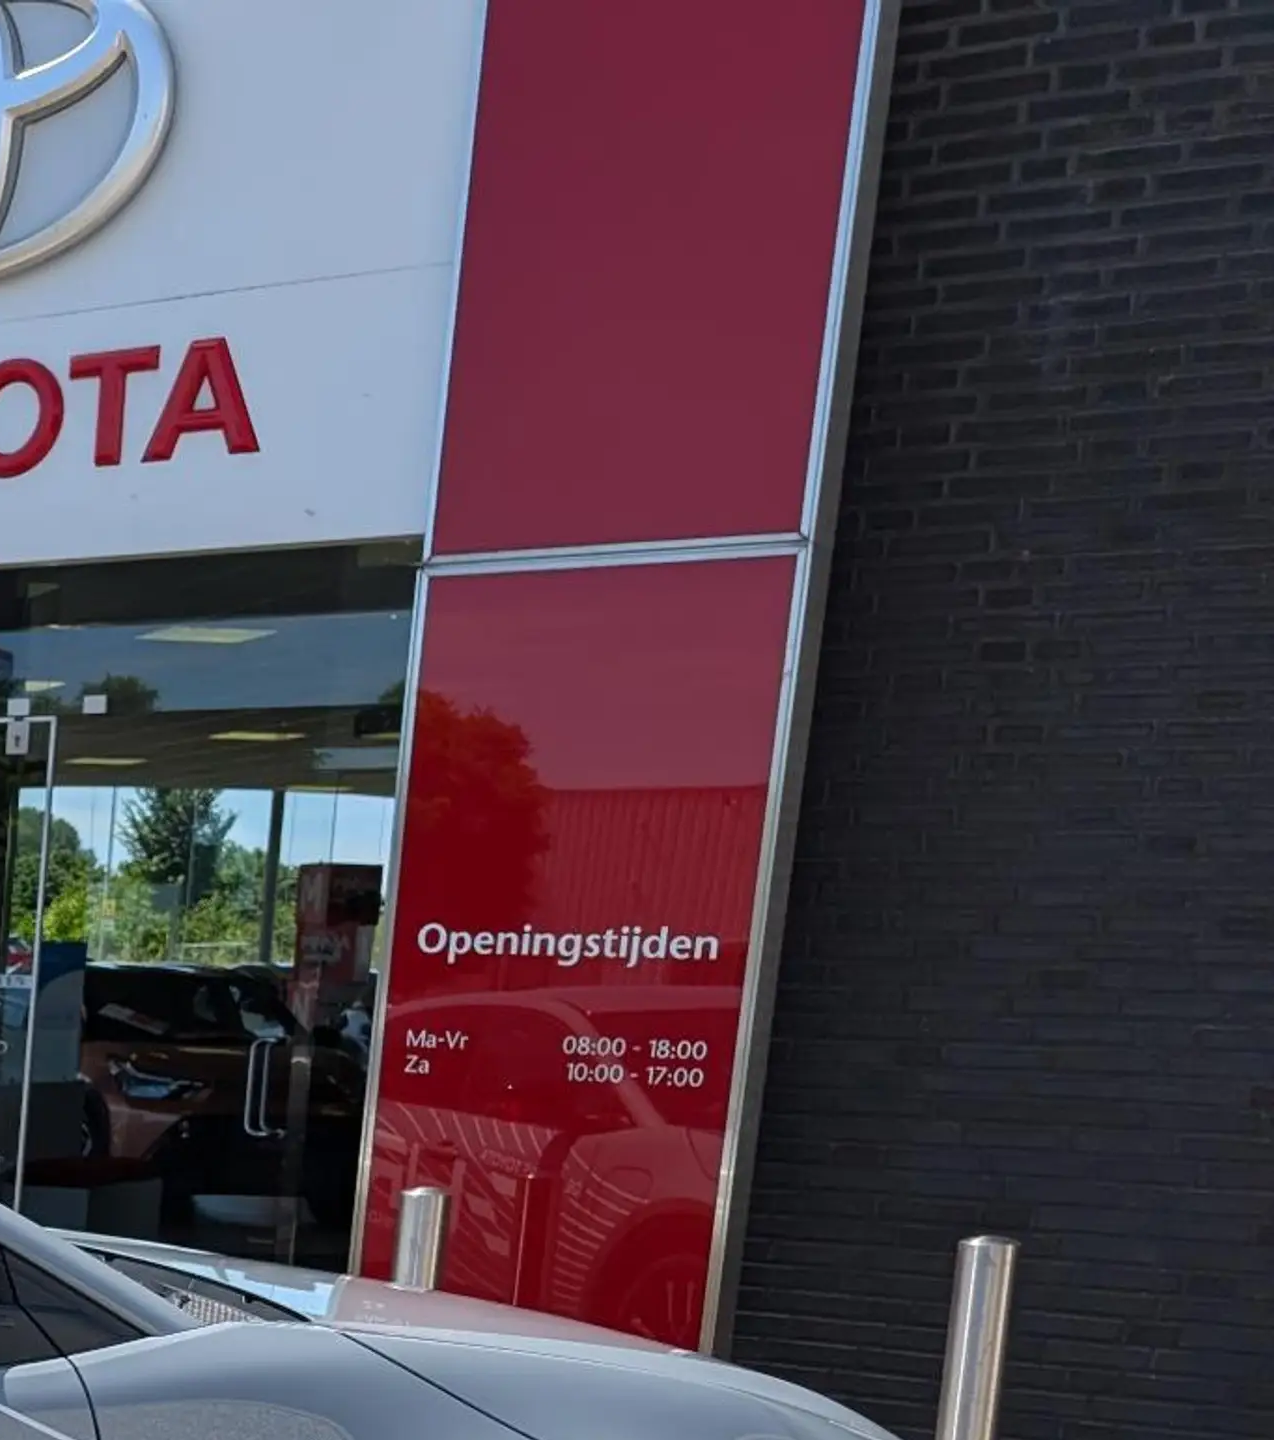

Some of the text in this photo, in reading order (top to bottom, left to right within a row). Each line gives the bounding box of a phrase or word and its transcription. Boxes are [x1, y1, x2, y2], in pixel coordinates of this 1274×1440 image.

[417, 922, 720, 968] Openingstijden
[405, 1029, 469, 1050] Ma-Vr
[562, 1036, 626, 1057] 08:00
[649, 1039, 708, 1061] 18:00
[404, 1055, 430, 1074] Za
[567, 1062, 624, 1084] 10:00
[646, 1066, 704, 1088] 17:00
